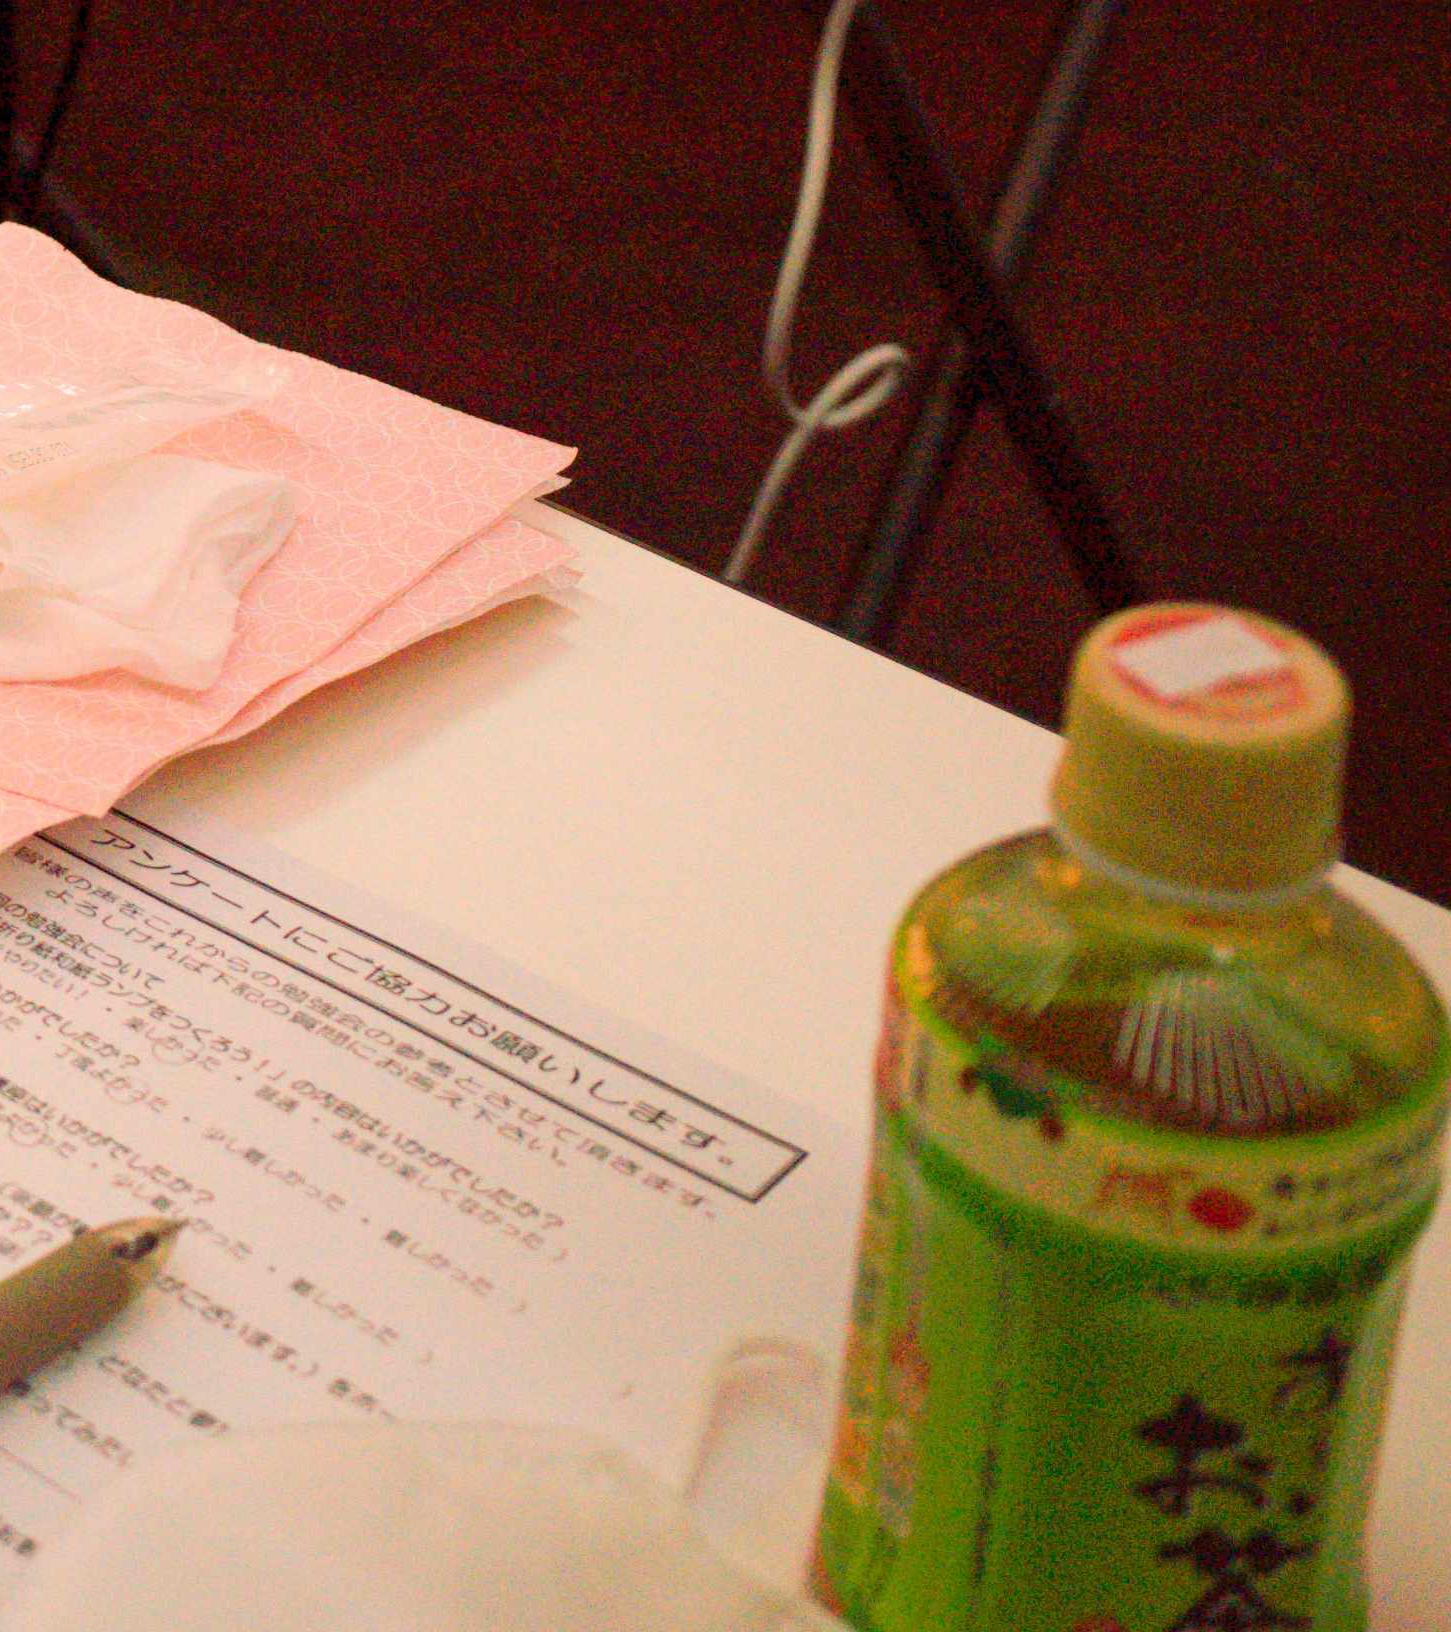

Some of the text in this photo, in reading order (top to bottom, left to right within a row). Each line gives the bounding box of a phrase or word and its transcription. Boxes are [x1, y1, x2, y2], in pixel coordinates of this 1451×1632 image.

[39, 885, 577, 1167] よろしければ下記の質問にお答え下さい。
[87, 828, 748, 1167] アンケートにご協力お願いします。
